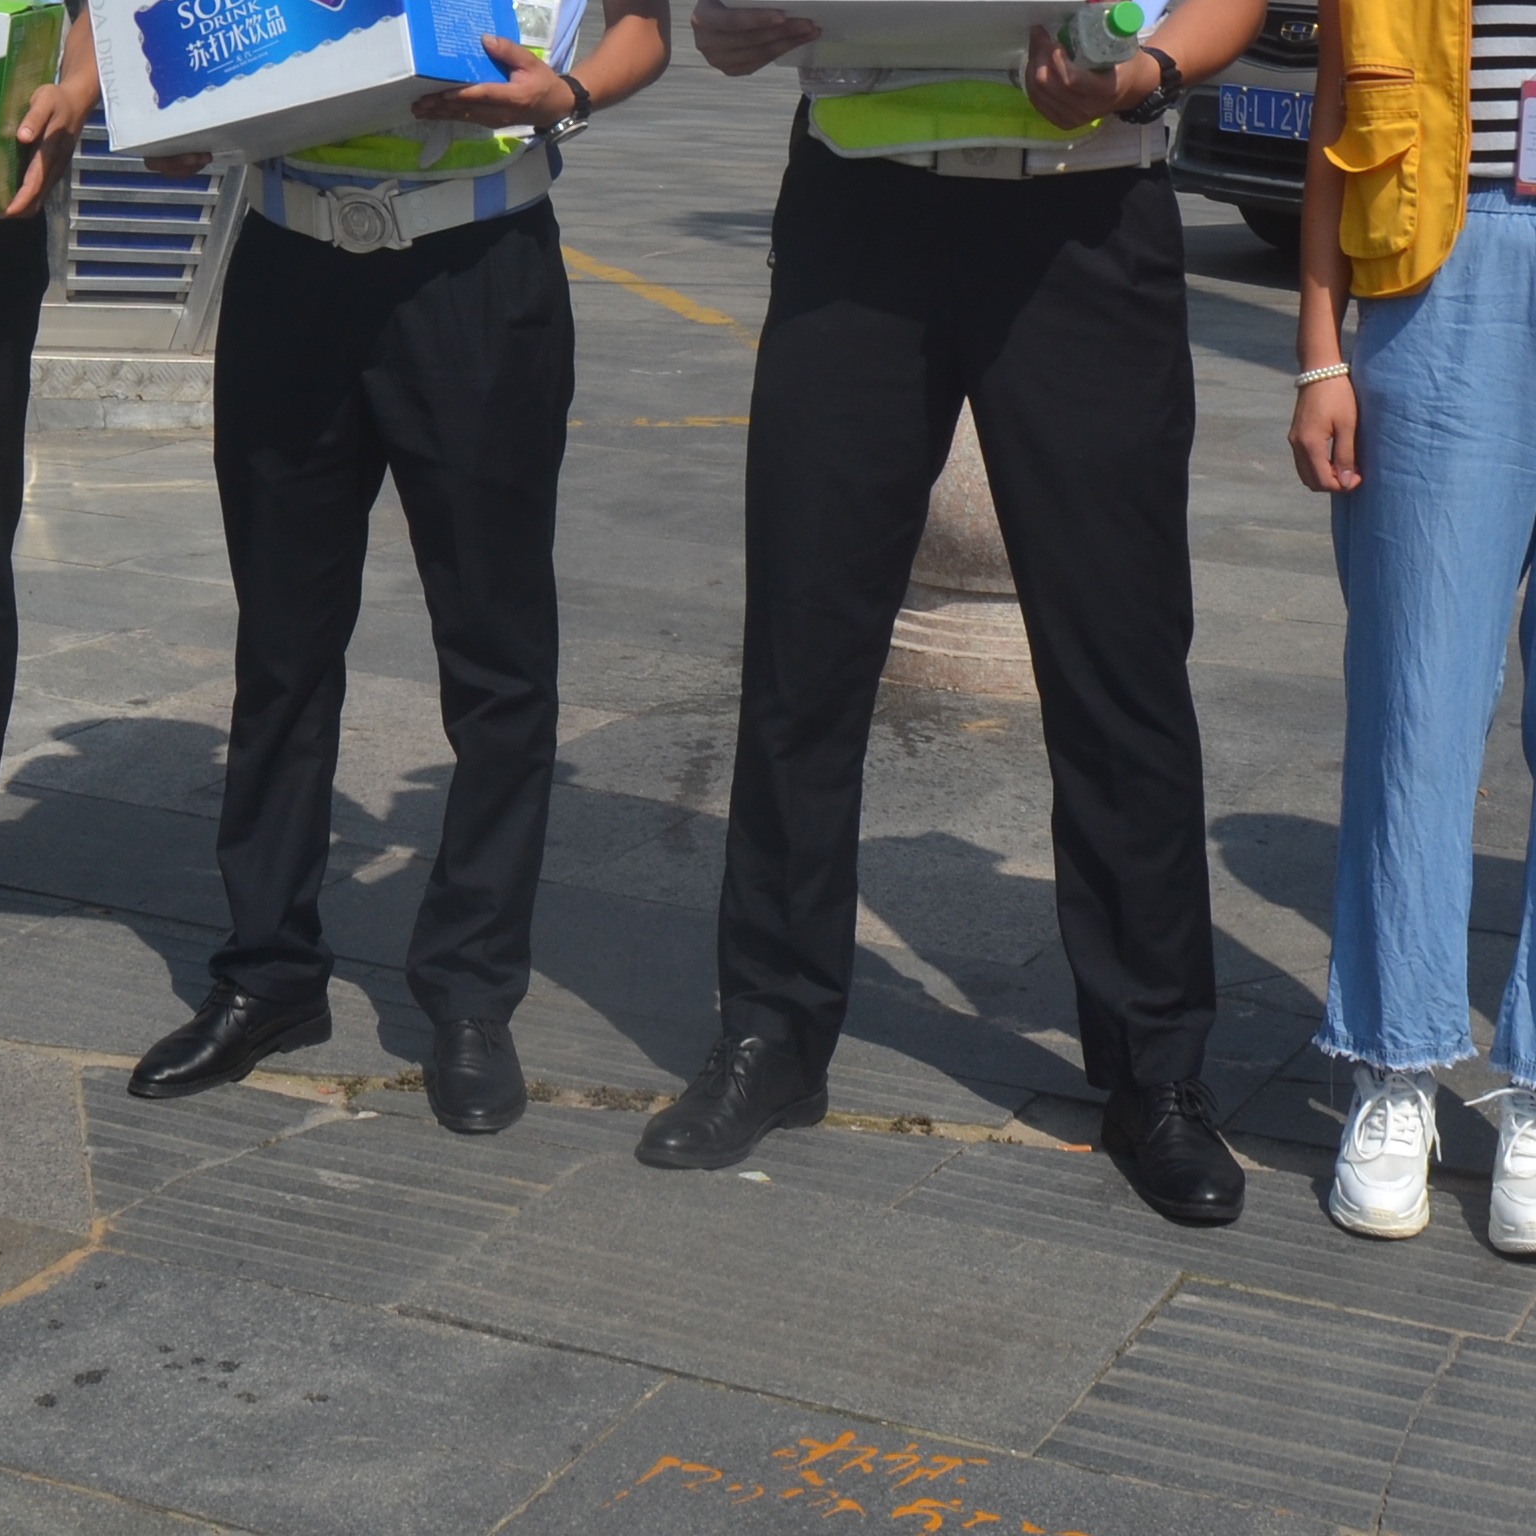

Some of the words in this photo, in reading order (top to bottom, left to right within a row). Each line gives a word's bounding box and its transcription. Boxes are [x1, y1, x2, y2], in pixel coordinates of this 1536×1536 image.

[186, 5, 288, 72] 苏打水饮品
